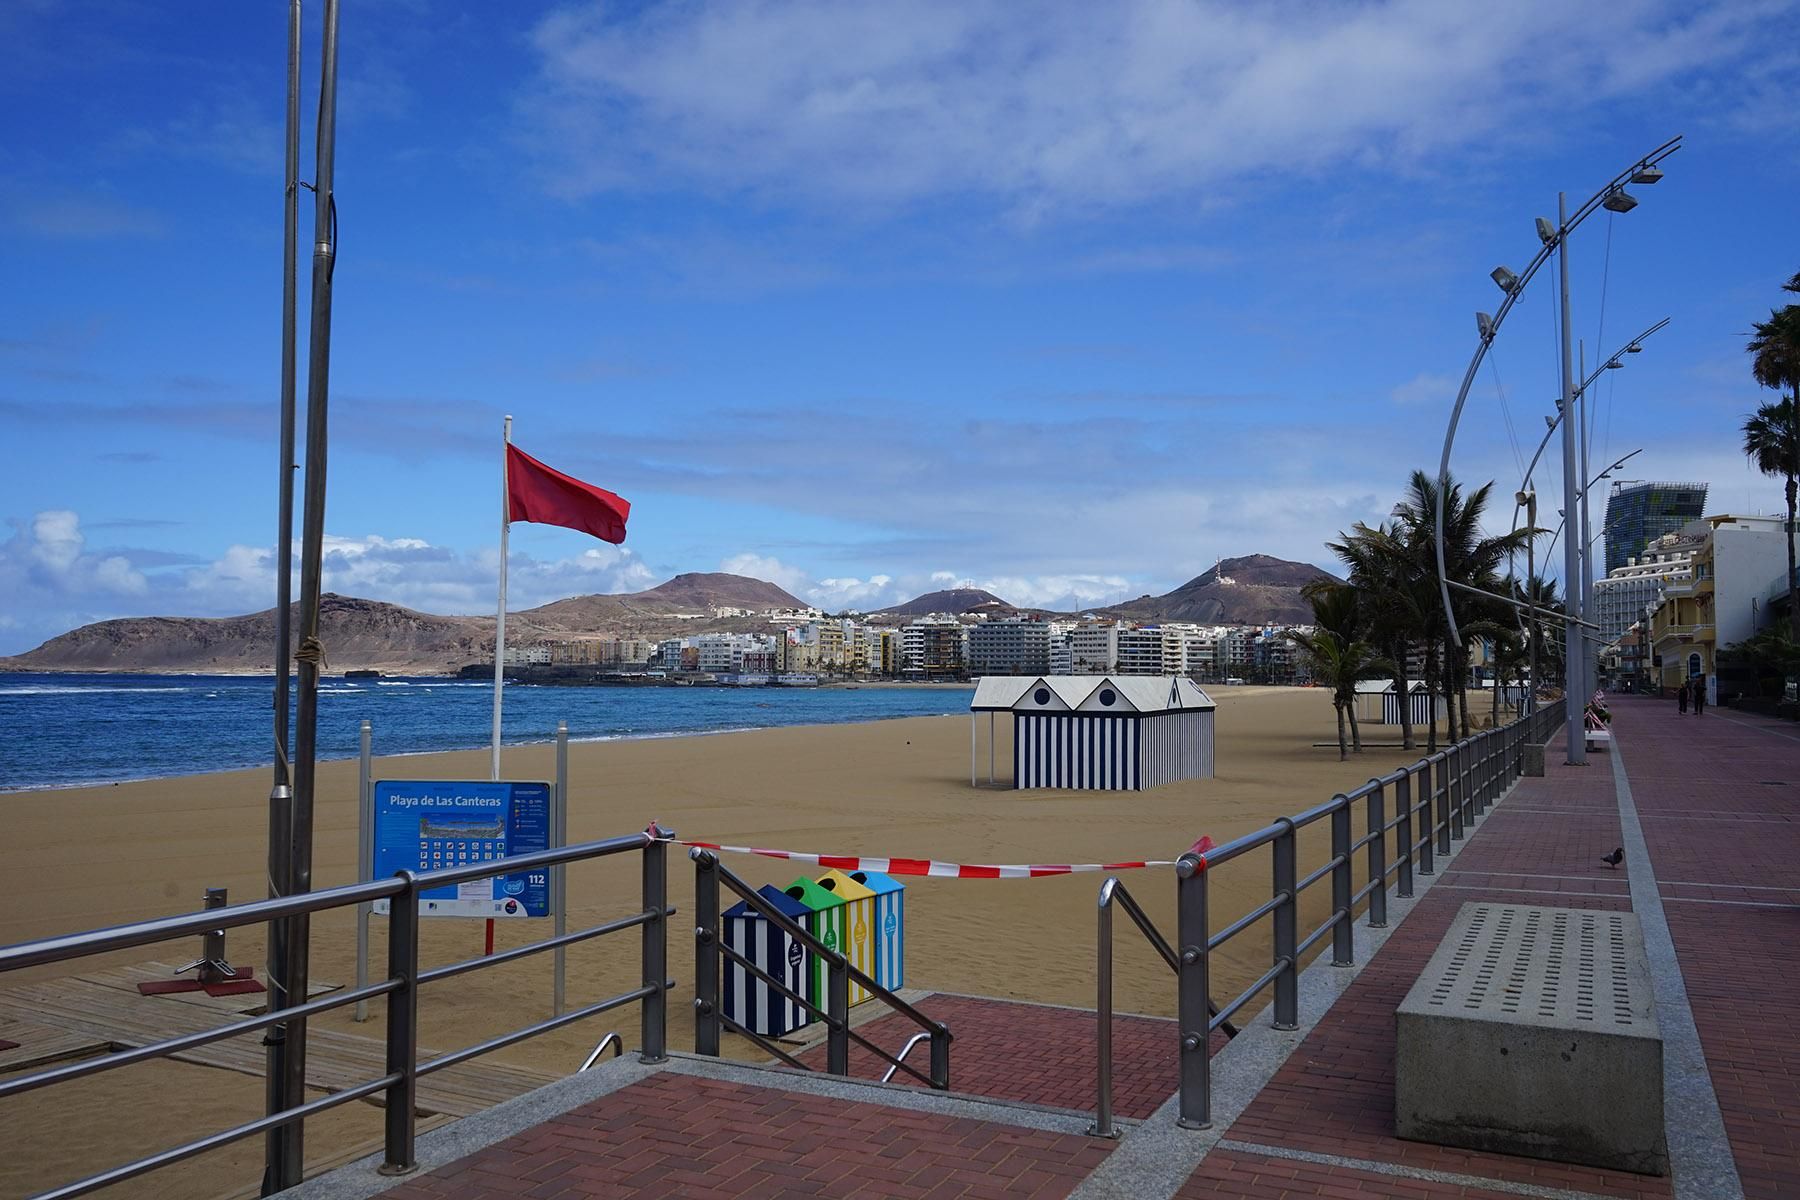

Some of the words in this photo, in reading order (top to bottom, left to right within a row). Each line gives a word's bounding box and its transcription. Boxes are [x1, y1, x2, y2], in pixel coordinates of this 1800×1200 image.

[390, 795, 418, 808] Playa
[420, 795, 434, 805] de
[436, 796, 453, 806] Las
[455, 796, 501, 807] Canteras
[529, 874, 545, 884] 112
